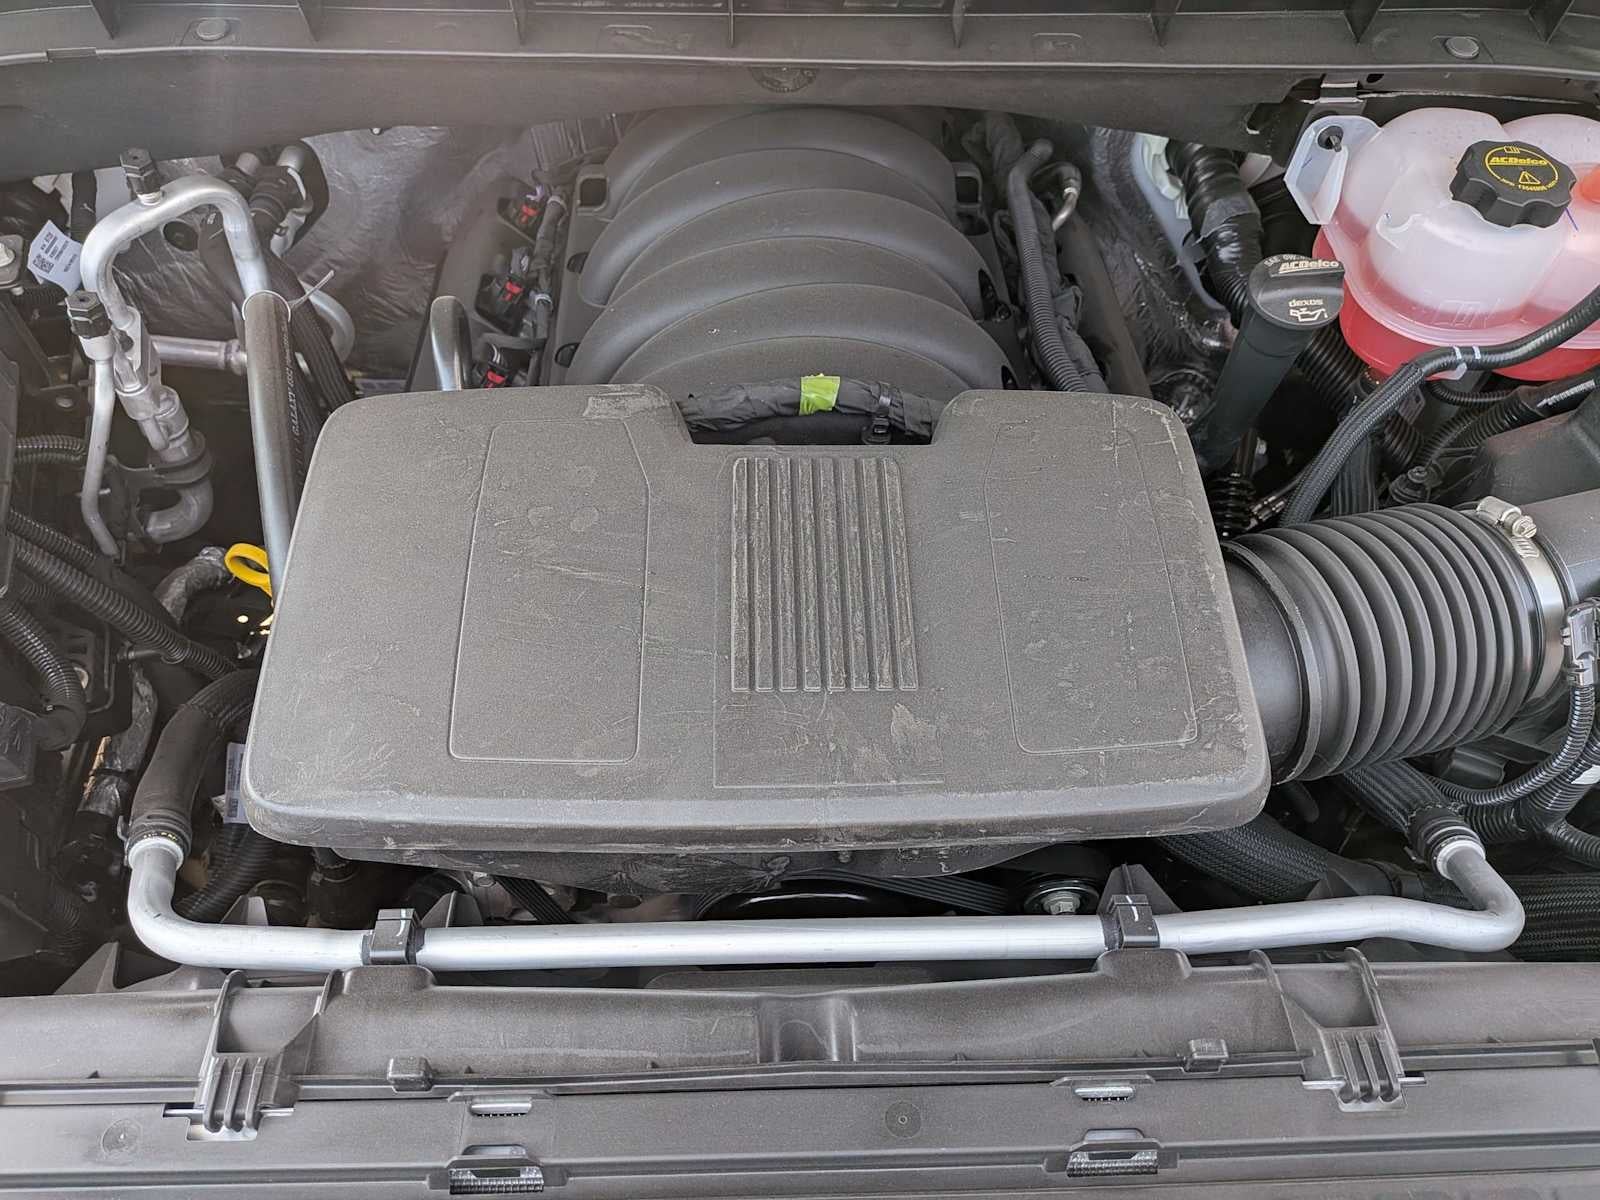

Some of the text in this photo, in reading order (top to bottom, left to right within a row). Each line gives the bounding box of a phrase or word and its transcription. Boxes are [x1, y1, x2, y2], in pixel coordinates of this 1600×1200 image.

[1489, 157, 1548, 165] ACDelco
[1280, 259, 1340, 272] ACDelco
[1288, 299, 1324, 307] dexos
